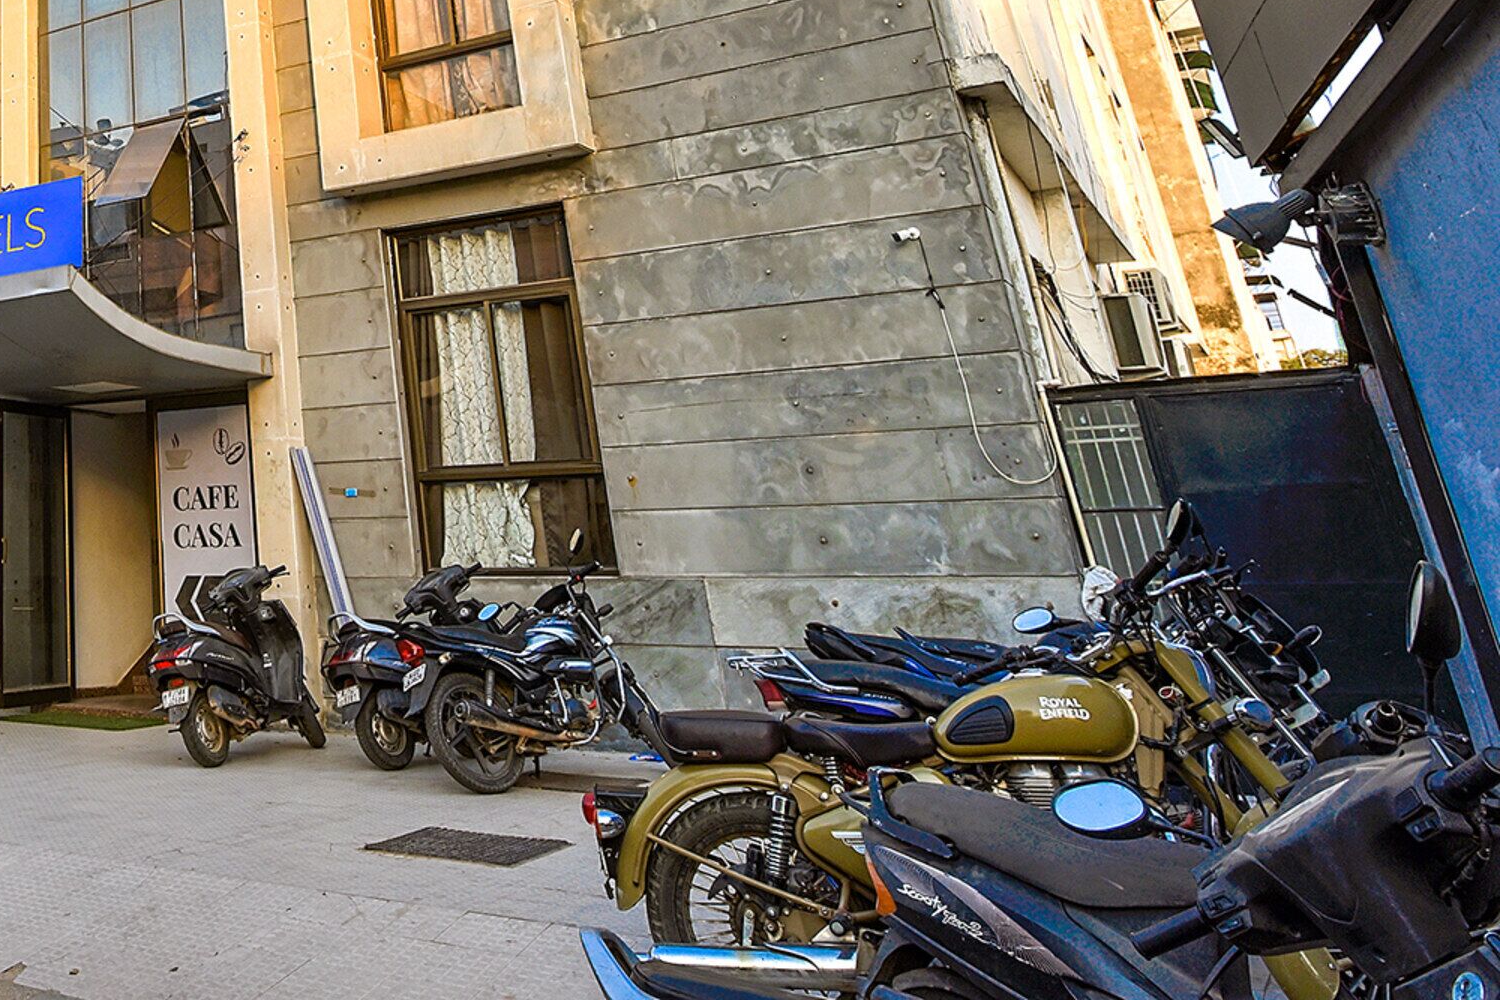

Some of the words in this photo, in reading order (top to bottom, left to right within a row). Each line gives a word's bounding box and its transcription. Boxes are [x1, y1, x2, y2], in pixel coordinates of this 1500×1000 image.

[172, 484, 240, 511] CAFE
[173, 522, 242, 549] CASA
[1038, 696, 1082, 708] ROYAL
[1039, 707, 1091, 721] ENFIELD
[896, 883, 948, 917] Scooty
